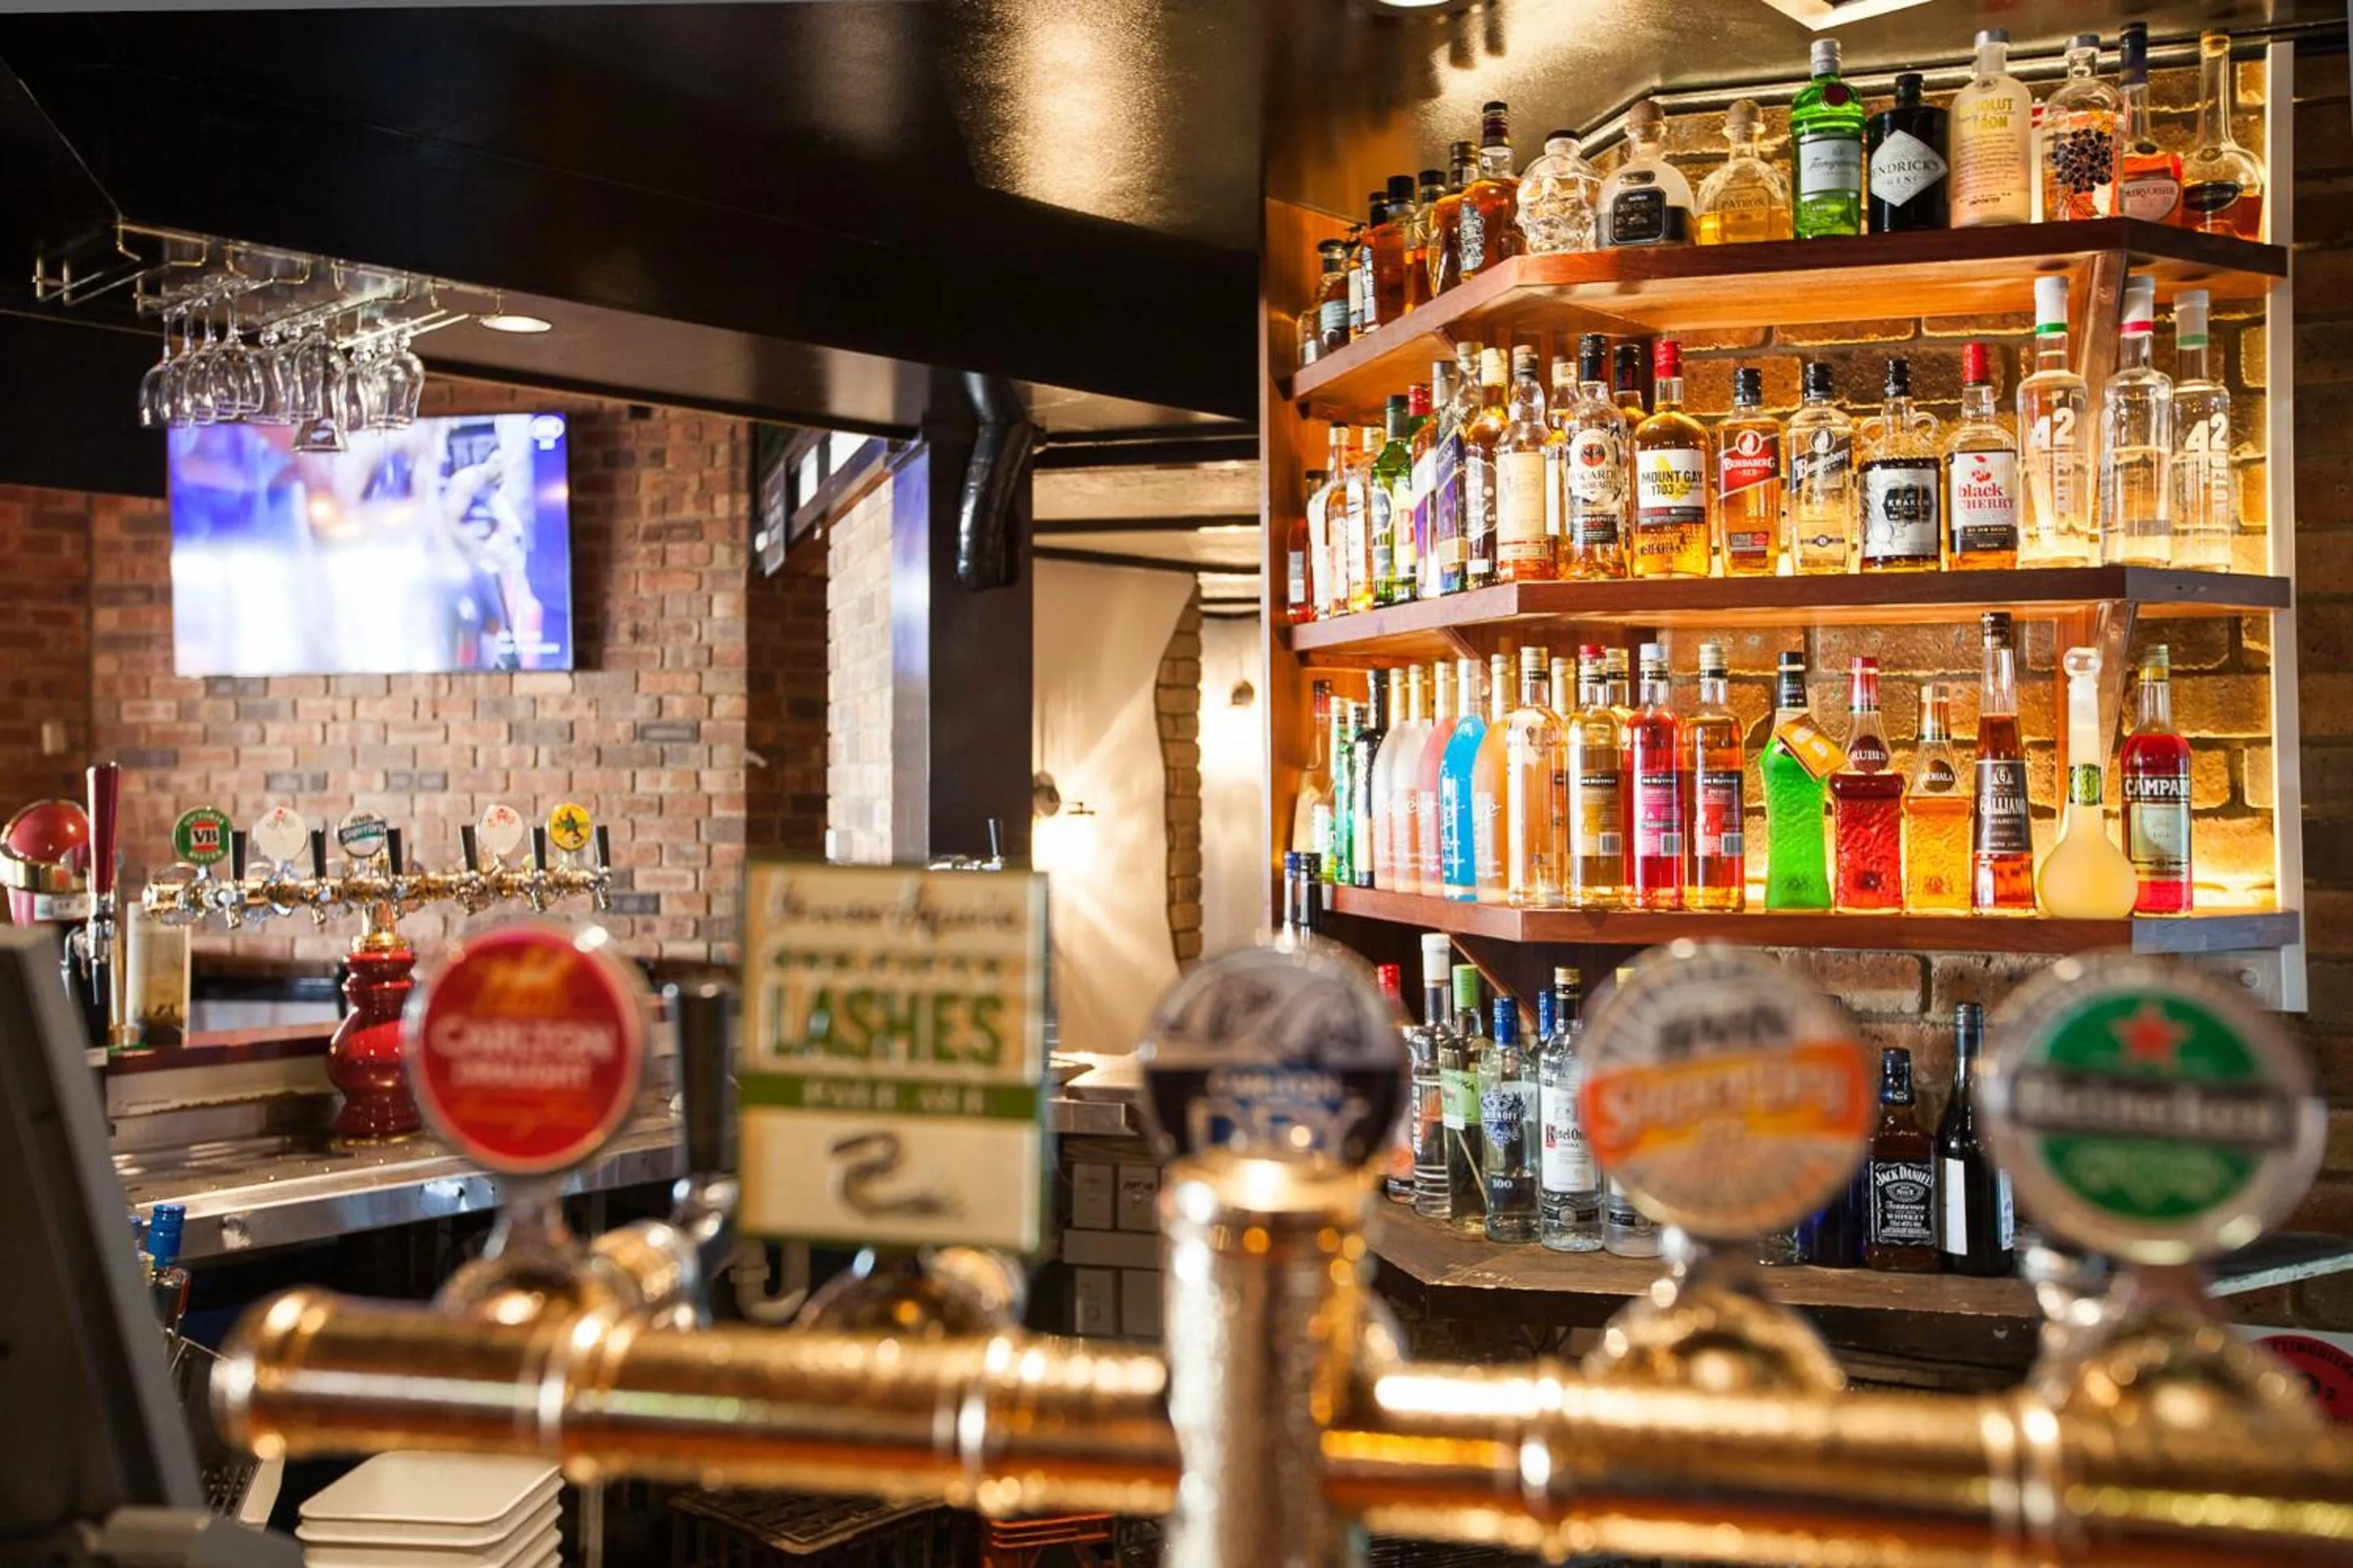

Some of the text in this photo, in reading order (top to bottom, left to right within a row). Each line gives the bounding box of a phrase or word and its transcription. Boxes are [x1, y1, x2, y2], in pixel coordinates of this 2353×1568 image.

[2029, 407, 2076, 450] 42
[2185, 412, 2228, 458] 42
[1641, 468, 1703, 485] MOUNT GAY
[1959, 482, 2004, 498] black
[1959, 497, 2016, 511] CHERRY
[193, 829, 218, 843] VB
[772, 982, 1004, 1069] LASHES
[1876, 1168, 1899, 1187] JACK
